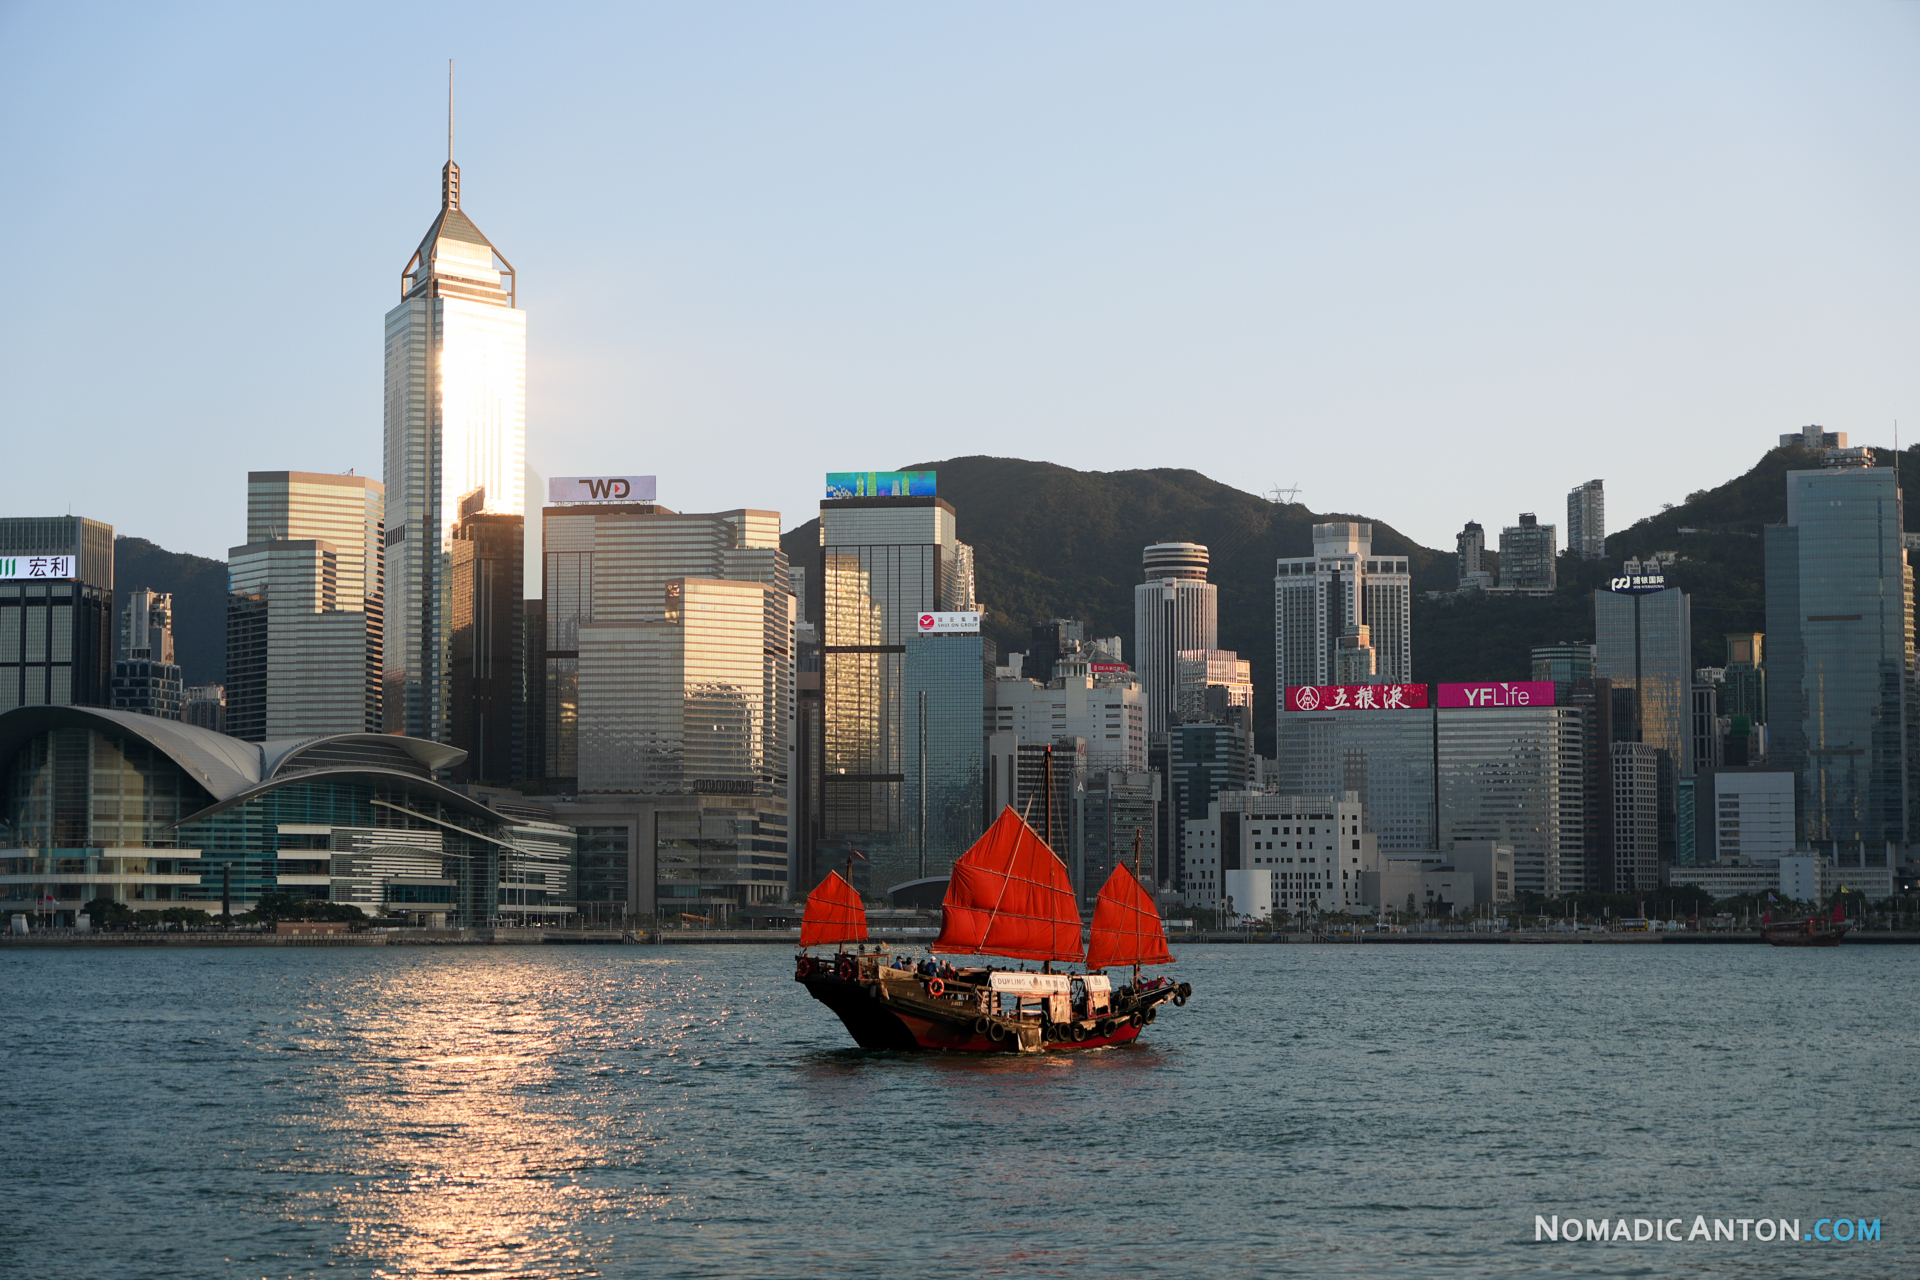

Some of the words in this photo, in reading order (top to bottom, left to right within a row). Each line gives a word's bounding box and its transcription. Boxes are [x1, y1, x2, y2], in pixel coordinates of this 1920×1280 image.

[579, 478, 630, 499] WD
[29, 556, 69, 577] 宏利
[1325, 685, 1411, 710] 五粮液
[1464, 683, 1530, 706] YFLife
